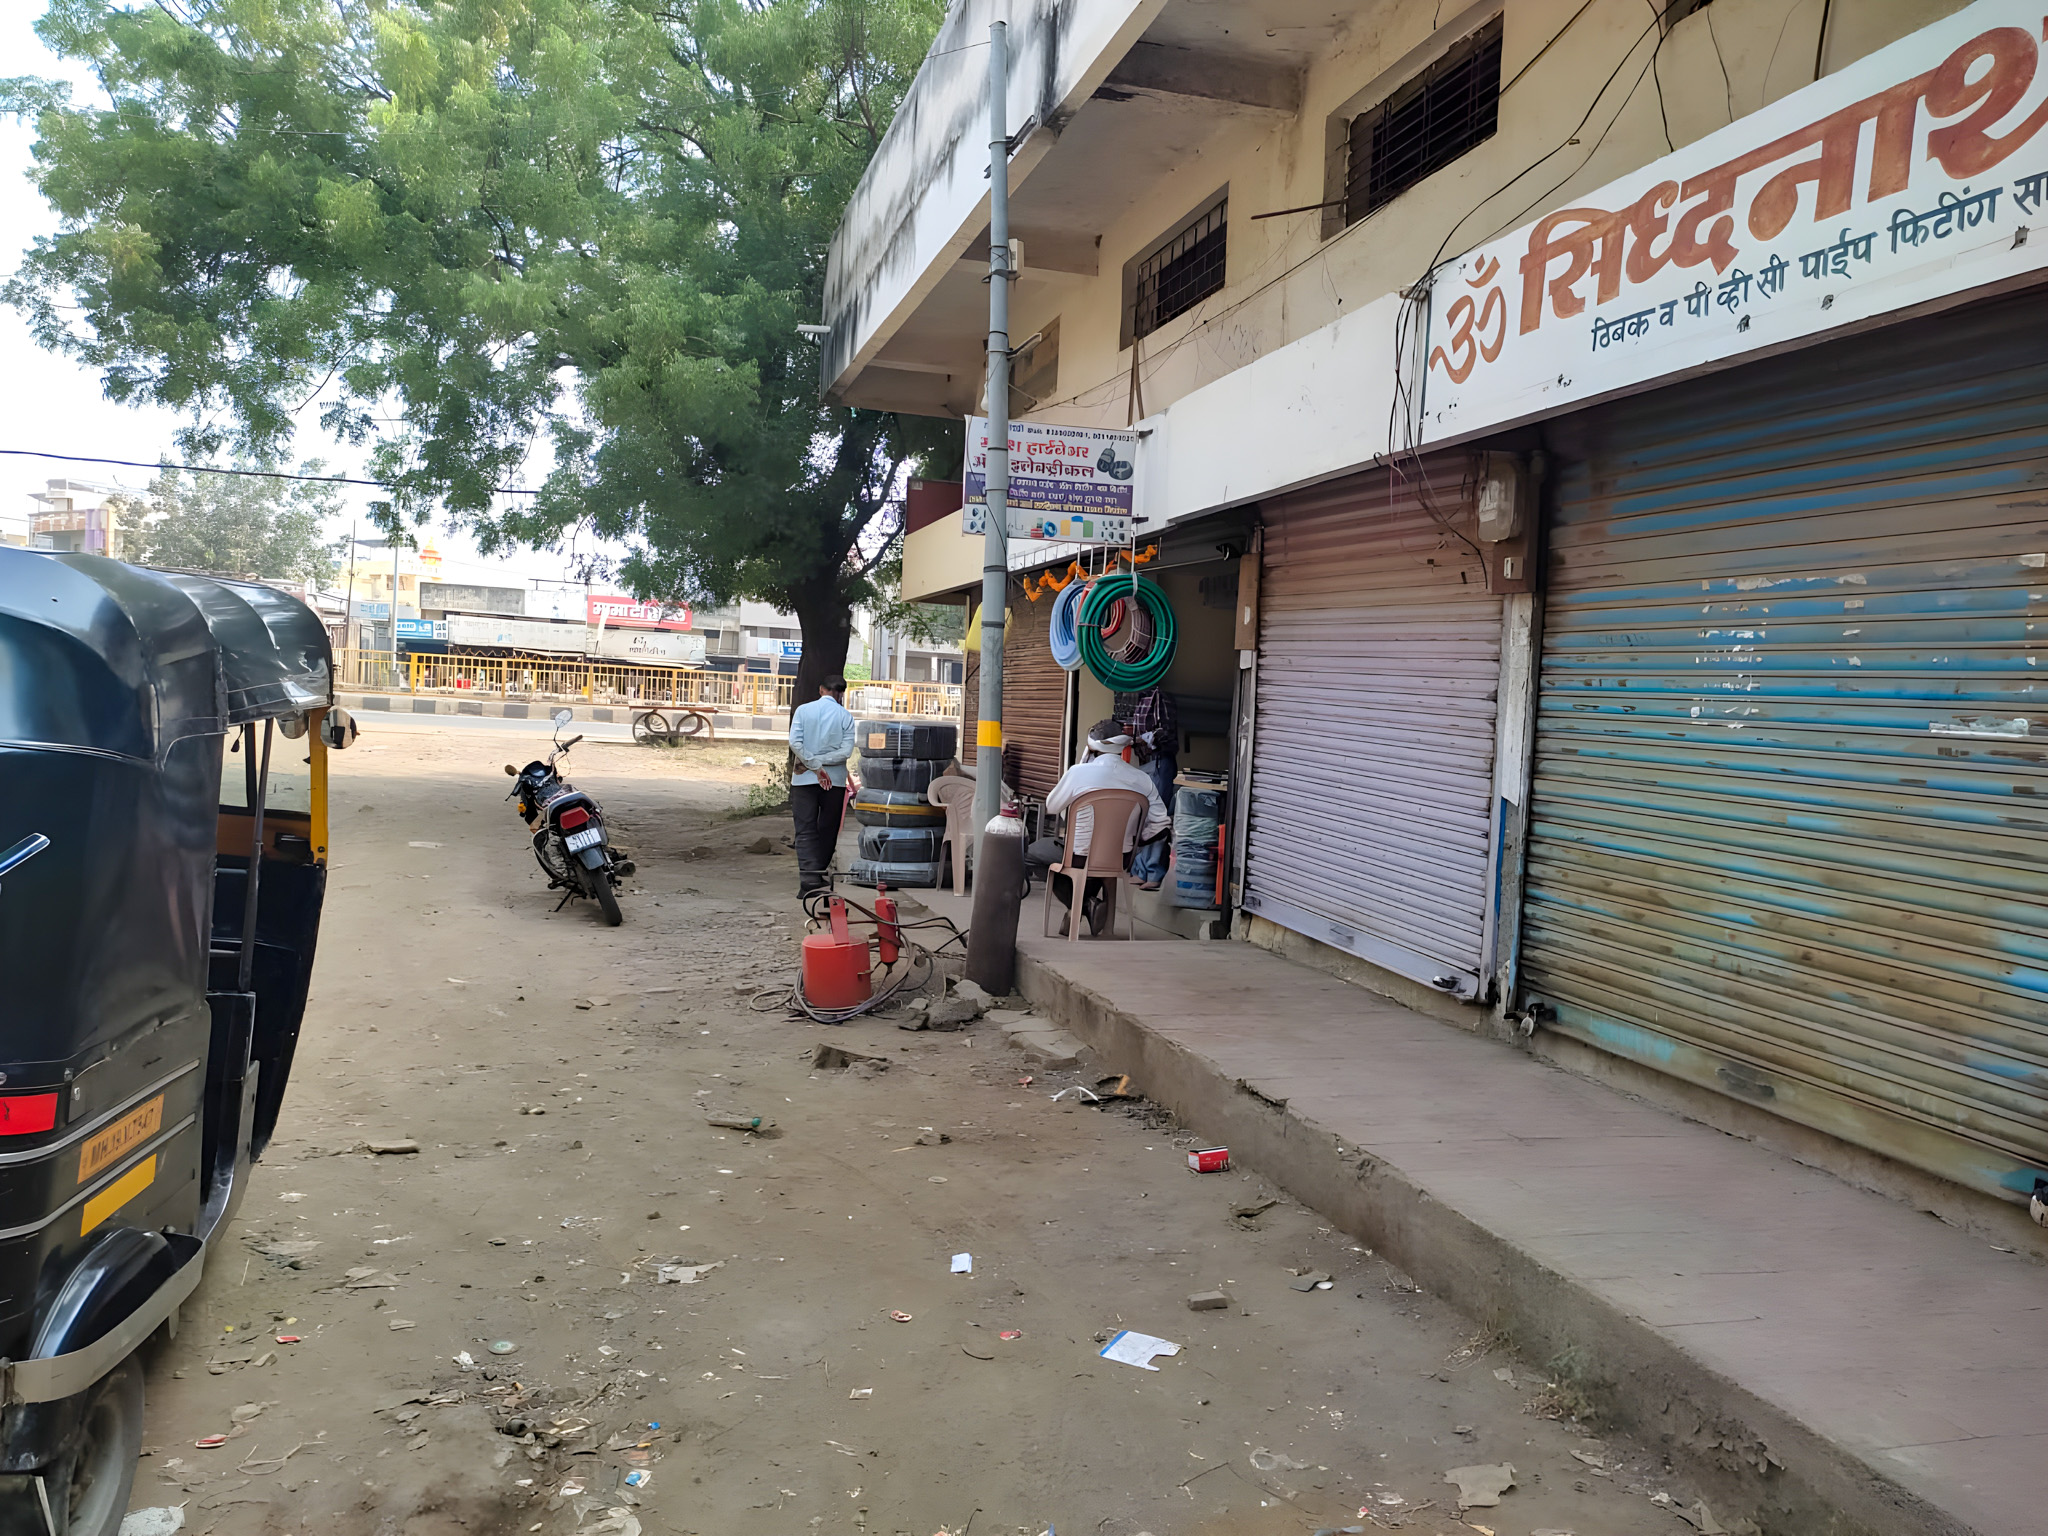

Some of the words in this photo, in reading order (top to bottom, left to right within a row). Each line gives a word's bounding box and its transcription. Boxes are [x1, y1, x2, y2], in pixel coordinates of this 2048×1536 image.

[1591, 307, 1656, 352] ठिबक
[1798, 227, 1878, 280] पाईप
[1886, 185, 2004, 254] फिटींग
